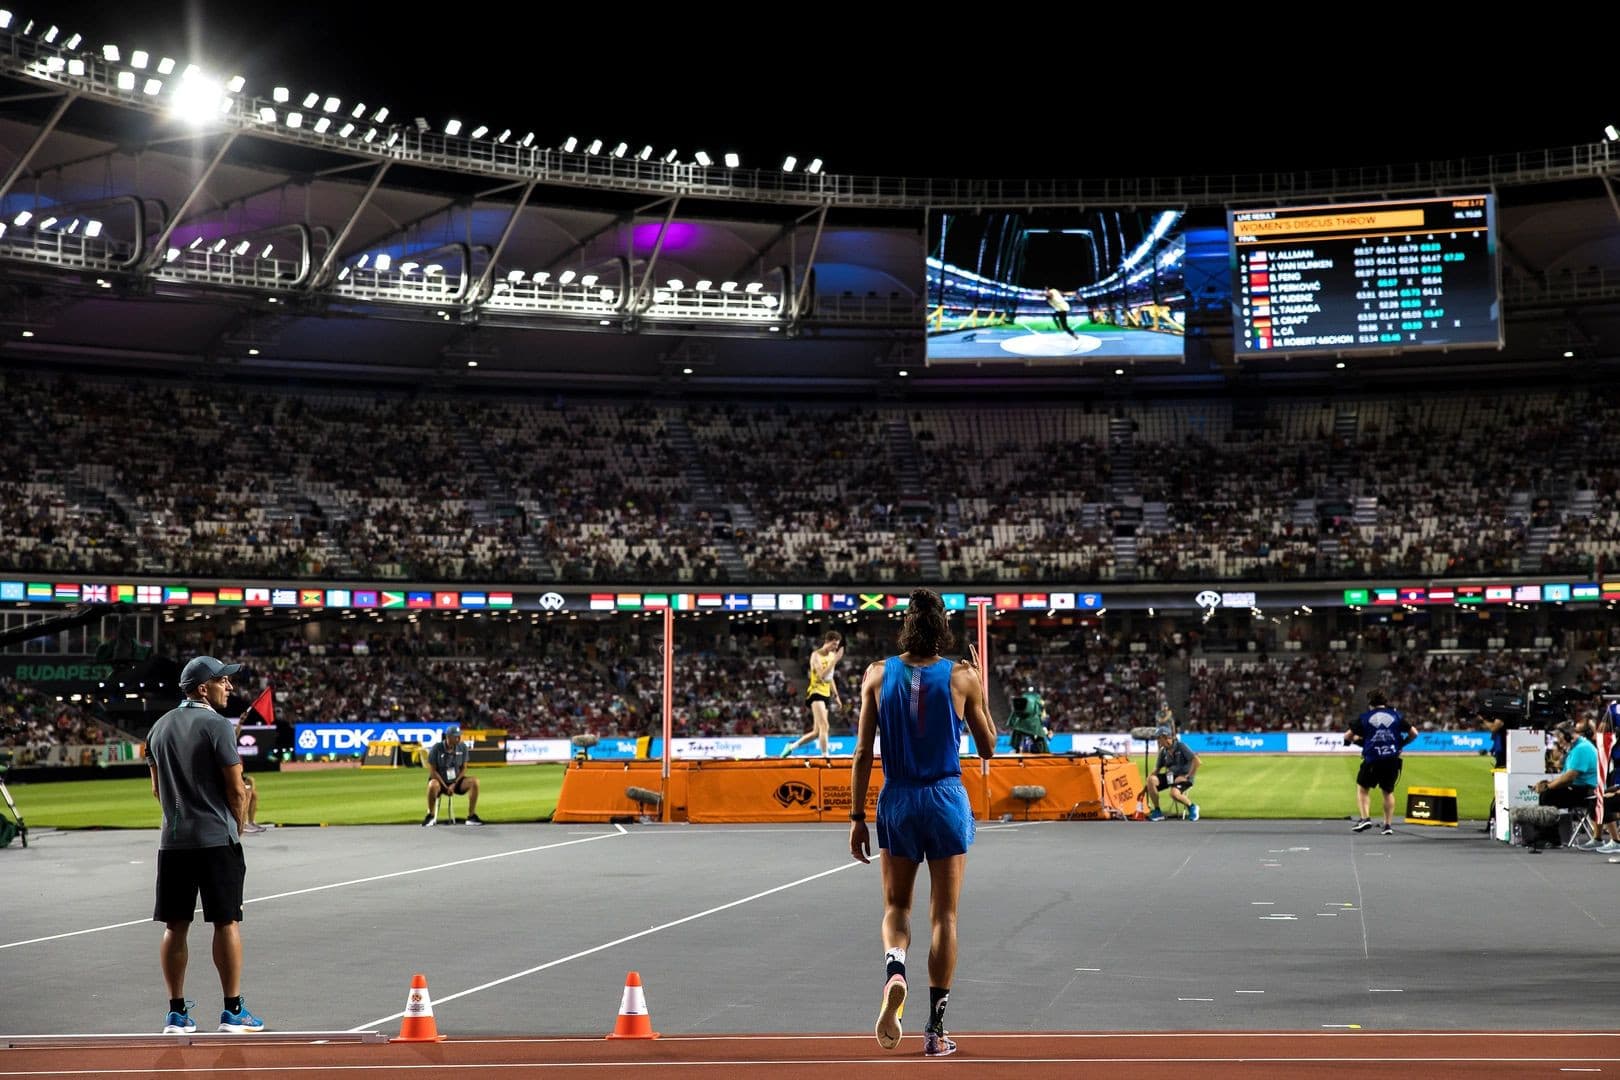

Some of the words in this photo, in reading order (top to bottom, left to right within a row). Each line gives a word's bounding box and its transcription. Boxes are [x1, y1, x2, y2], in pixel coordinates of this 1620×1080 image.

[1240, 220, 1292, 232] WOMEN'S
[1294, 218, 1333, 230] DISCUS
[1336, 216, 1376, 226] THROW
[1278, 249, 1314, 260] ALLMAN
[1277, 262, 1296, 270] VAN
[1278, 272, 1301, 282] FENG
[1280, 304, 1320, 314] TAUSAGA
[1280, 316, 1308, 325] CRAFT
[1284, 335, 1354, 346] ROBERT-MICHON
[316, 729, 373, 748] TDK
[1232, 736, 1264, 748] Tokyo
[1452, 735, 1482, 748] Tokyo
[523, 743, 550, 755] Tokyo
[617, 741, 637, 754] Toky
[714, 740, 742, 752] Tokyo
